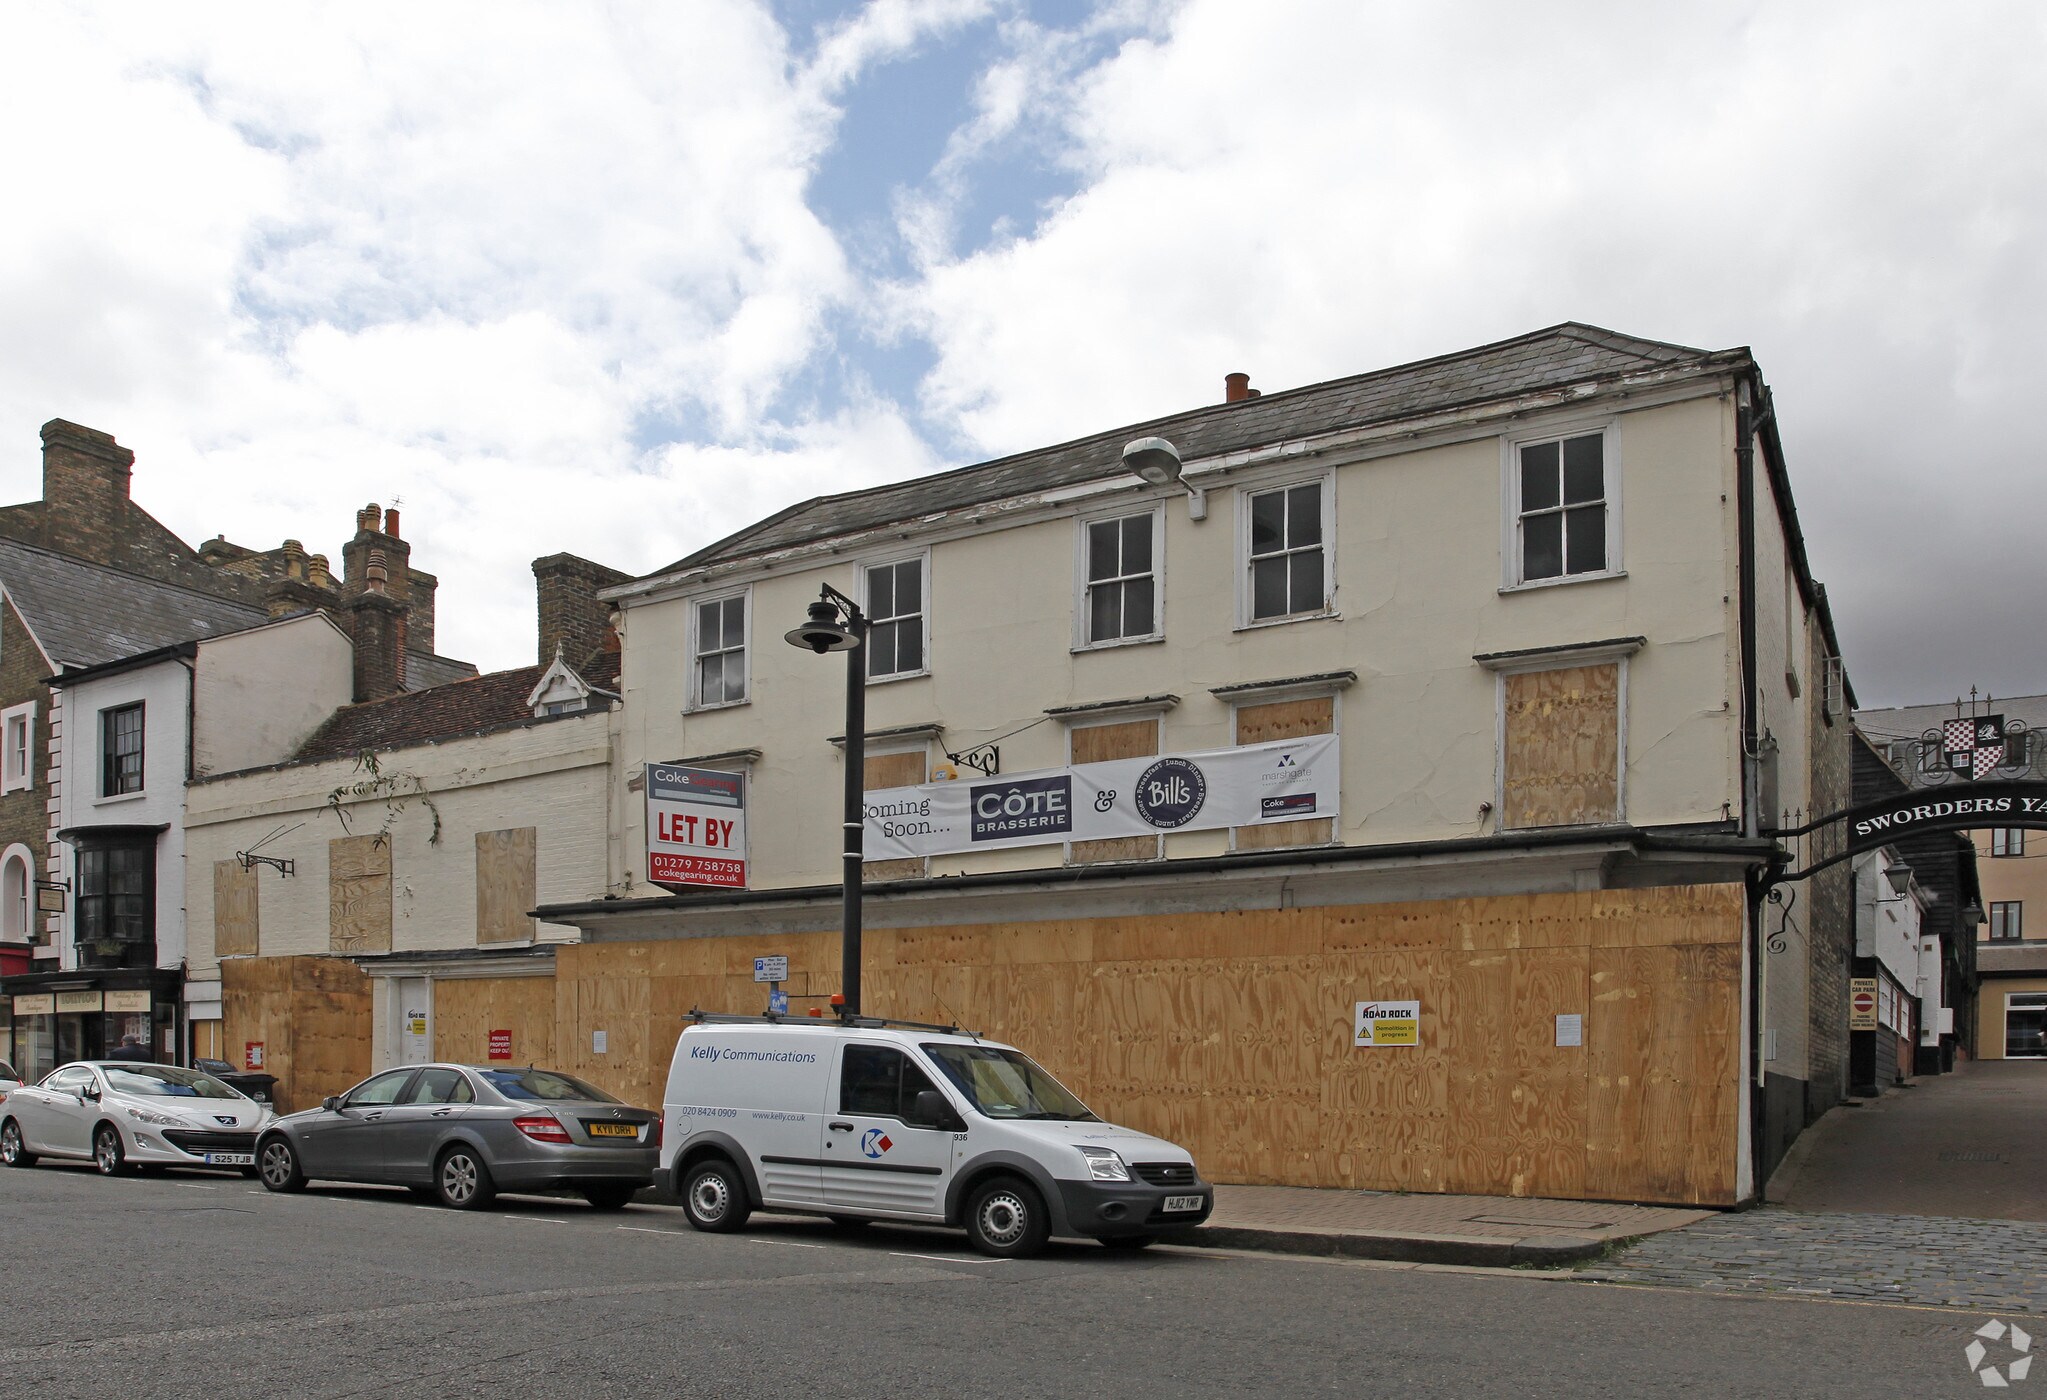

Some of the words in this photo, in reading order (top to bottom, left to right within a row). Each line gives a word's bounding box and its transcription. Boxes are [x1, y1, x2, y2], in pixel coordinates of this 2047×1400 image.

[1137, 762, 1163, 794] Breakfast
[1165, 759, 1188, 768] Lunch
[1187, 764, 1205, 787] Dinner
[1262, 768, 1312, 781] marshgate
[1094, 789, 1117, 812] &
[1147, 776, 1191, 808] Bill's
[976, 788, 1066, 819] CÔTE
[976, 814, 1066, 833] BRASSERIE
[1855, 797, 2013, 836] SWORDERS
[658, 812, 698, 844] LET
[705, 818, 735, 848] BY
[654, 856, 692, 869] 01279
[697, 860, 741, 873] 758758
[658, 868, 738, 883] cokegearing.co.uk
[1363, 1010, 1386, 1018] ROAD
[1389, 1010, 1411, 1018] ROCK
[691, 1046, 721, 1062] Kelly
[722, 1048, 816, 1063] Communications
[683, 1106, 697, 1115] 020
[697, 1107, 716, 1116] 8424
[717, 1109, 737, 1118] 0909
[752, 1112, 806, 1122] www.kelly.co.uk
[596, 1125, 613, 1134] KY11
[215, 1155, 233, 1163] S25
[235, 1155, 251, 1163] TJB
